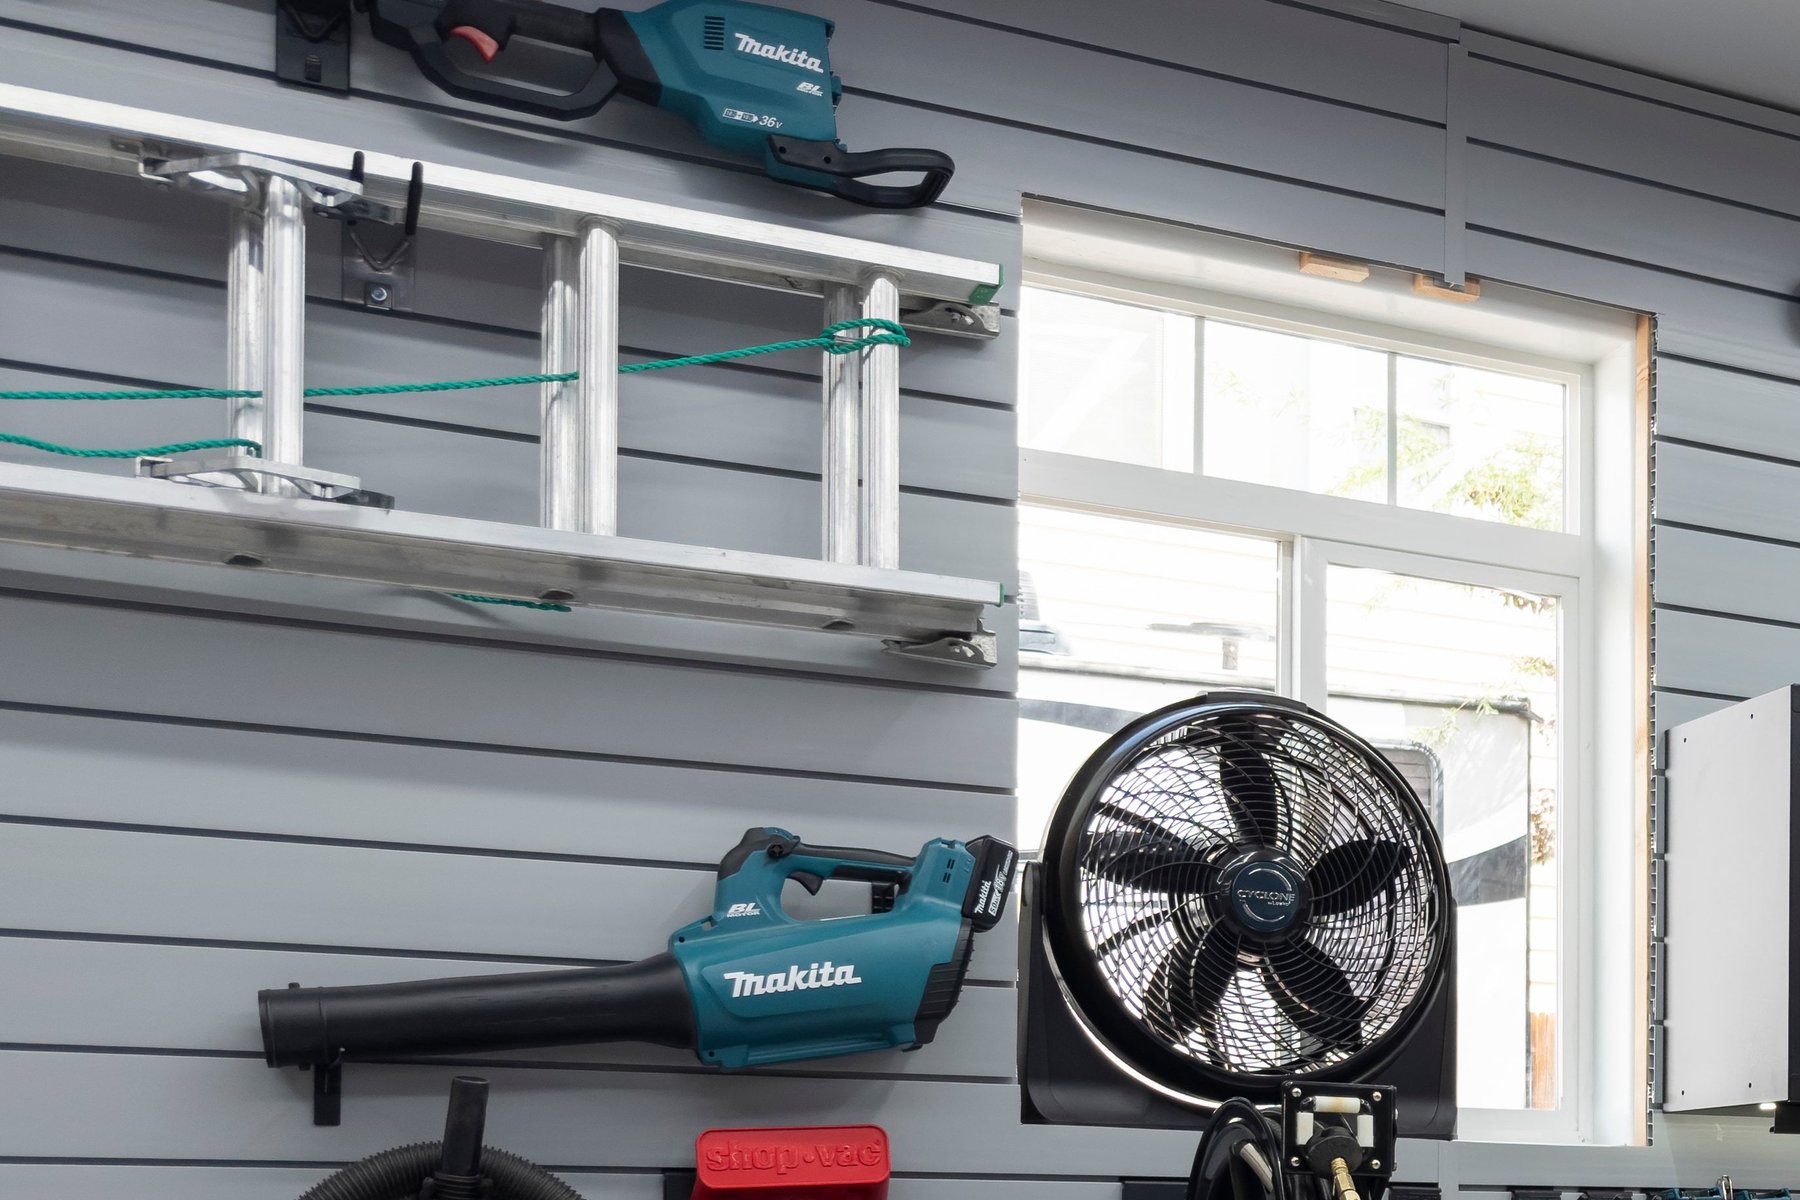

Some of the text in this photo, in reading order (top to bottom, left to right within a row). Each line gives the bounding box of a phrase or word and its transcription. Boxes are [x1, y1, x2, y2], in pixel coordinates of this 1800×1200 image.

[759, 115, 783, 128] 36V
[1237, 889, 1295, 902] CYCLONE
[728, 902, 760, 914] BL
[723, 961, 862, 998] Makita
